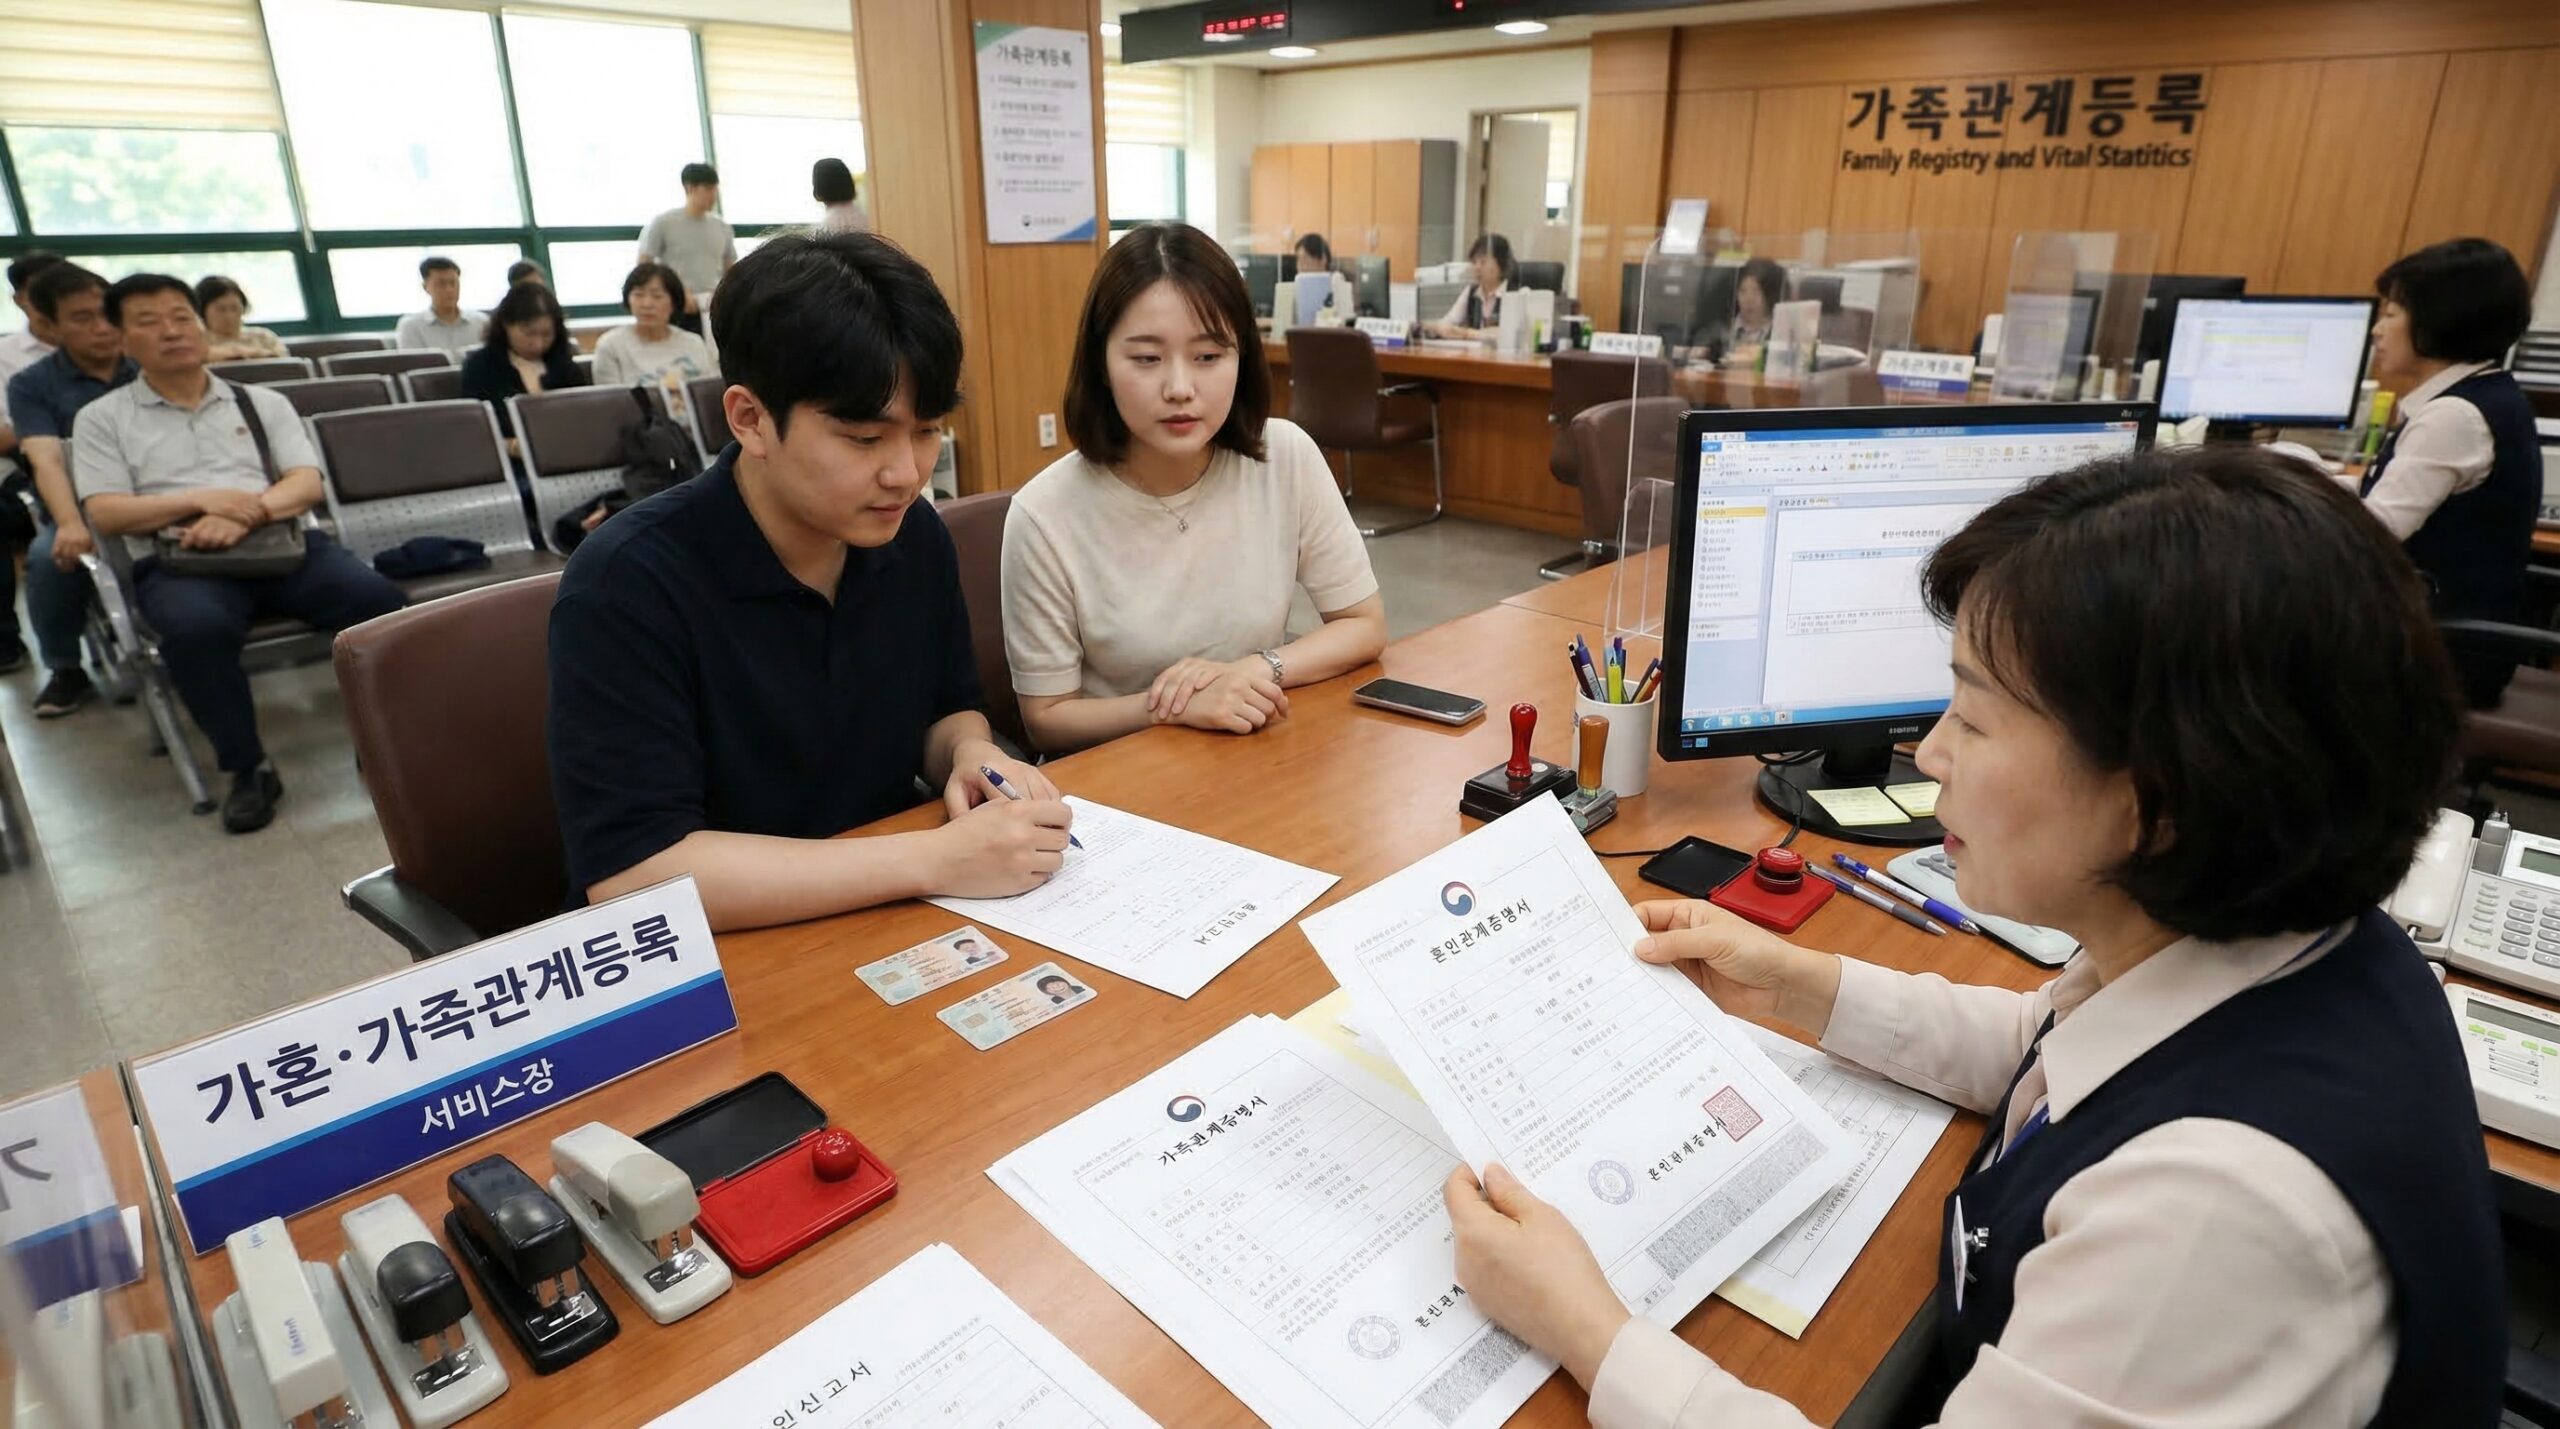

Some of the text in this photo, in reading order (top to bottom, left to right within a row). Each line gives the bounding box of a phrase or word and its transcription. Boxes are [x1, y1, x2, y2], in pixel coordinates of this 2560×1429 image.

[1848, 73, 2206, 141] 가족관계등록
[1841, 143, 2191, 175] Family Registry and Vital Statitics
[1430, 898, 1531, 963] 혼인관계증명서
[420, 1058, 556, 1136] 서비스장
